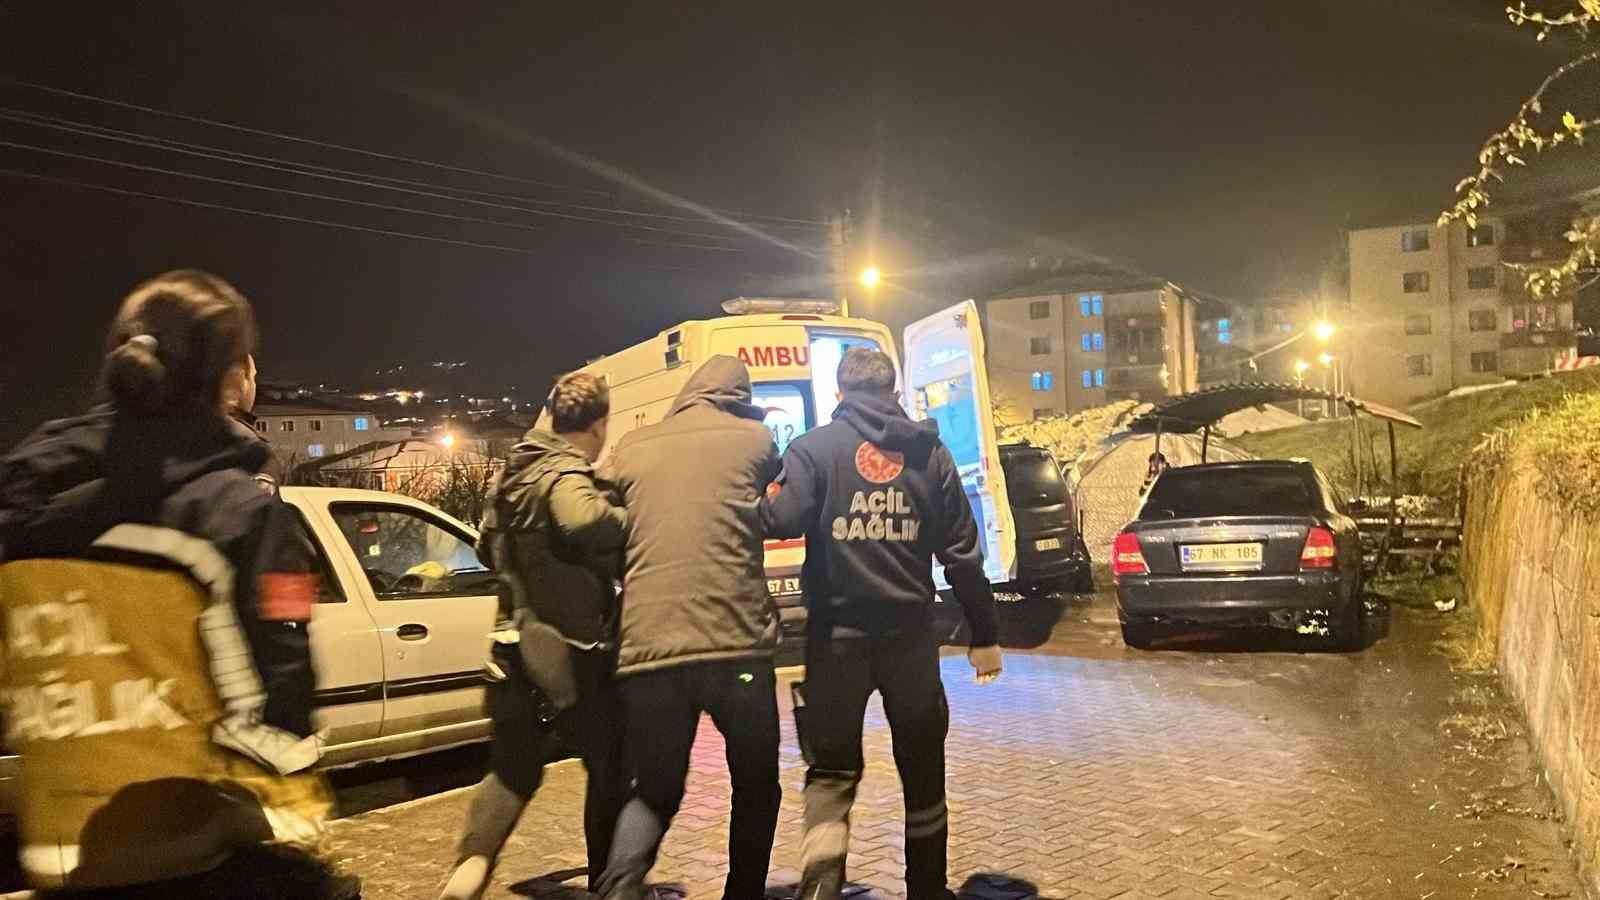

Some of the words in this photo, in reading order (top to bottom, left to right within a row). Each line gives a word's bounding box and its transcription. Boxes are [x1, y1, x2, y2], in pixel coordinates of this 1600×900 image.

[737, 346, 809, 367] AMBU
[849, 486, 912, 514] ACİL
[832, 513, 920, 541] SAĞLIK
[1191, 548, 1204, 561] 67
[767, 579, 781, 593] 67
